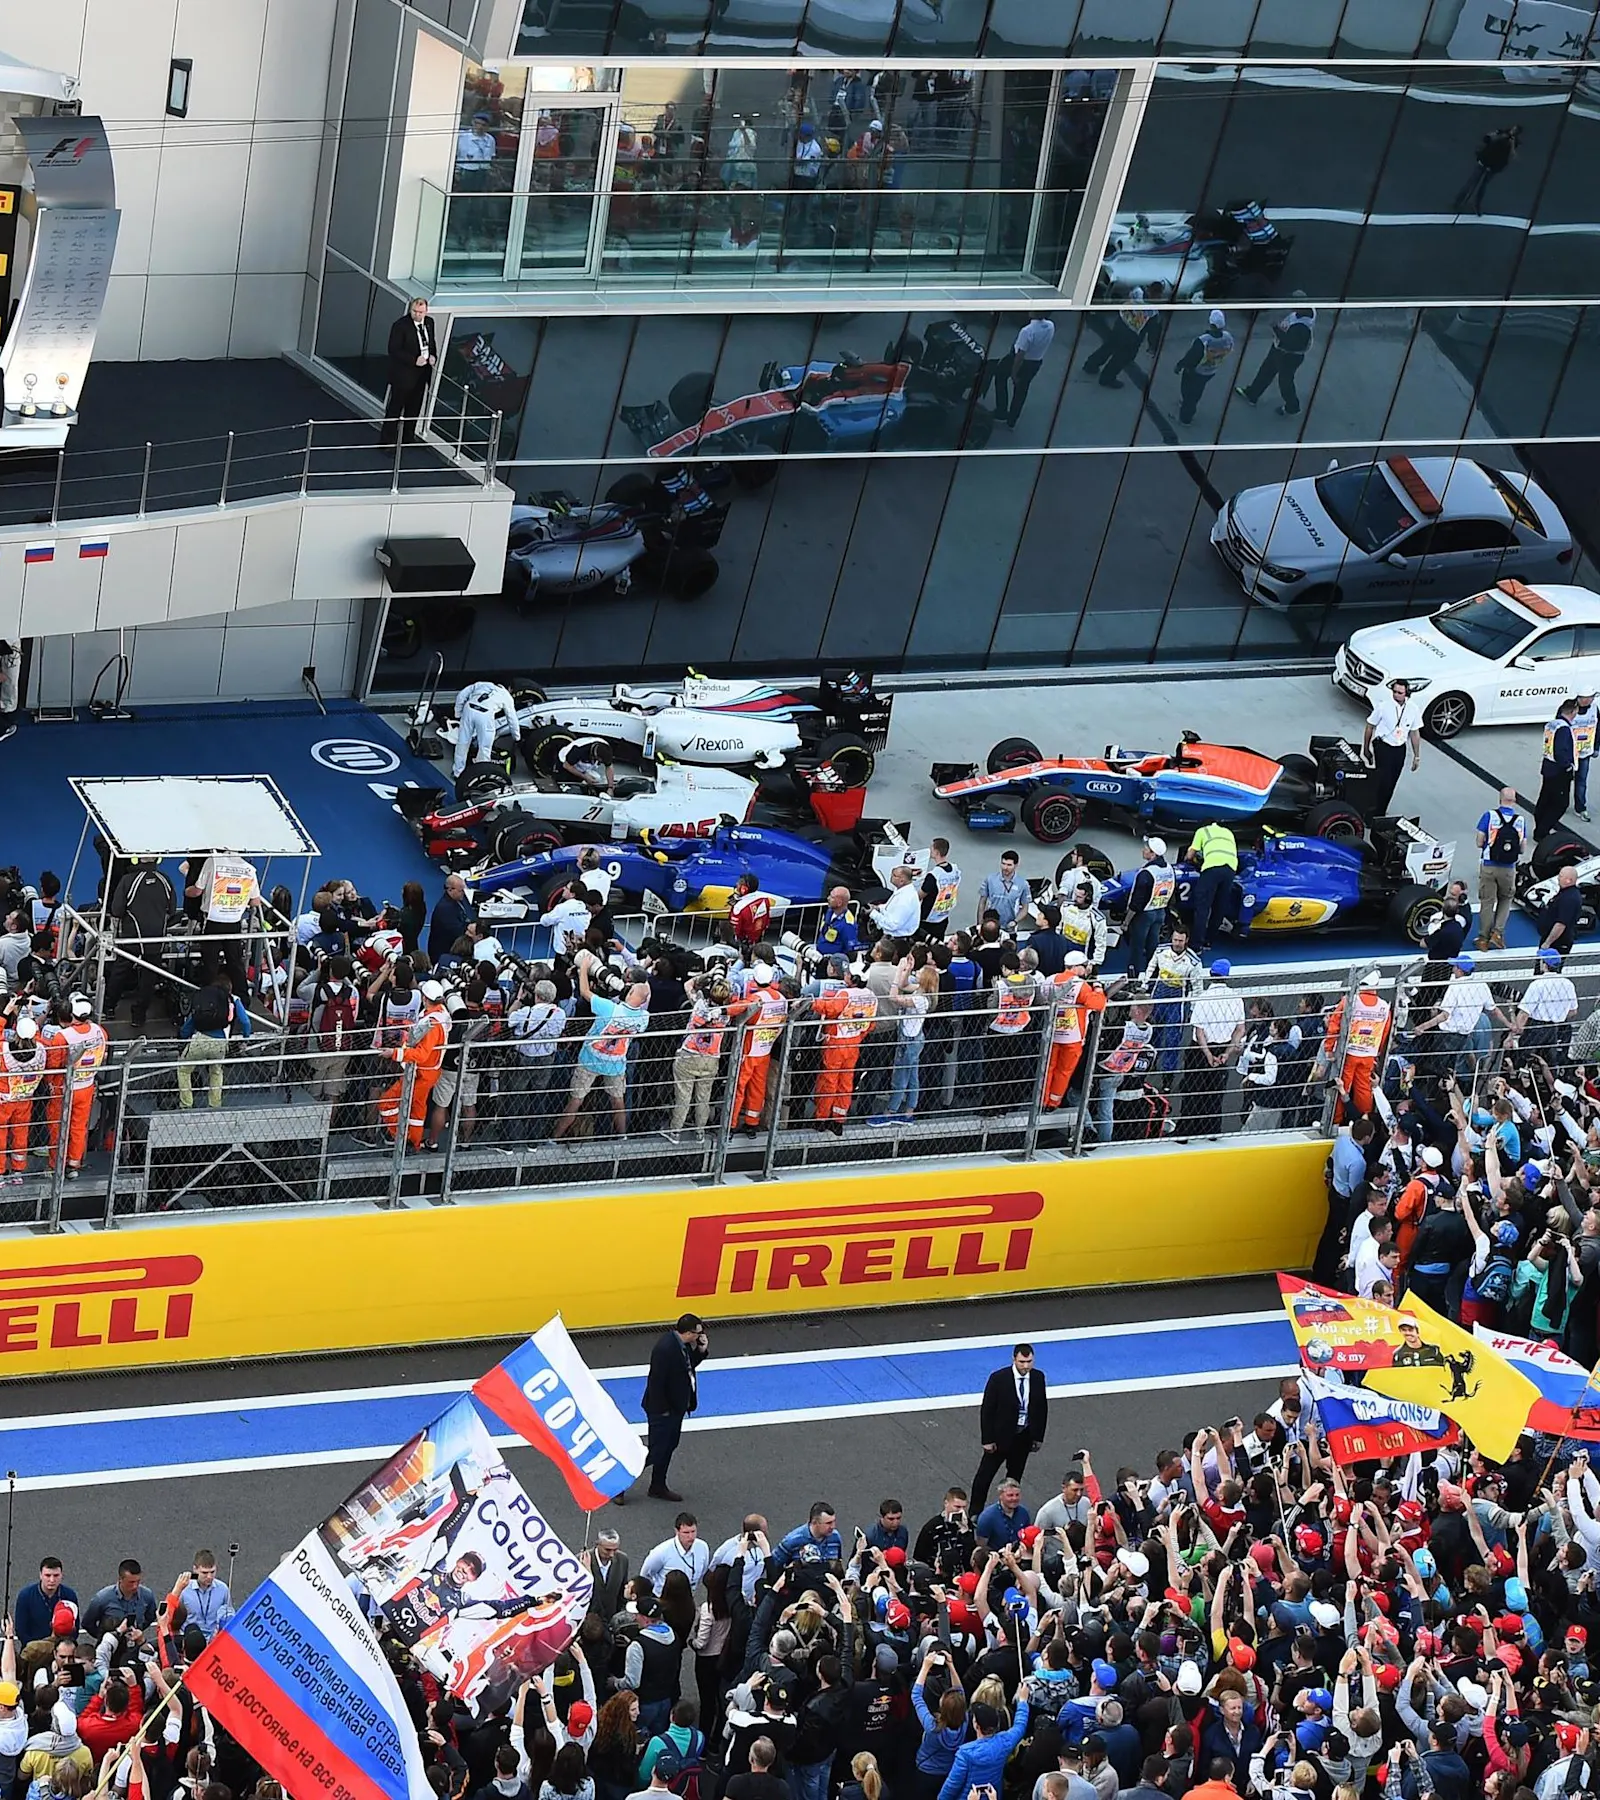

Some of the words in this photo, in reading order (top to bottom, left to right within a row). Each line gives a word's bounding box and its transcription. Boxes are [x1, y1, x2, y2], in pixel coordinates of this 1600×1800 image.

[699, 684, 730, 692] randstad
[1500, 688, 1524, 698] RACE
[1526, 686, 1569, 697] CONTROL
[696, 737, 744, 751] Rexona
[1092, 783, 1116, 792] KIKY
[582, 806, 604, 821] 21
[608, 861, 622, 880] 9
[676, 1191, 1045, 1298] PIRELLI
[1311, 1321, 1338, 1336] You
[1333, 1334, 1347, 1346] in
[1348, 1353, 1365, 1365] my
[1386, 1402, 1432, 1421] ALONSO
[522, 1368, 617, 1484] СОЧИ
[477, 1500, 541, 1591] СОЧИ
[508, 1494, 593, 1602] РОССИ
[242, 1611, 302, 1669] Могучая
[255, 1593, 352, 1699] Россия-любимая
[345, 1690, 378, 1729] наша
[205, 1655, 240, 1694] Твоё
[232, 1685, 300, 1753] достоянье
[295, 1746, 316, 1770] на
[311, 1760, 337, 1789] все
